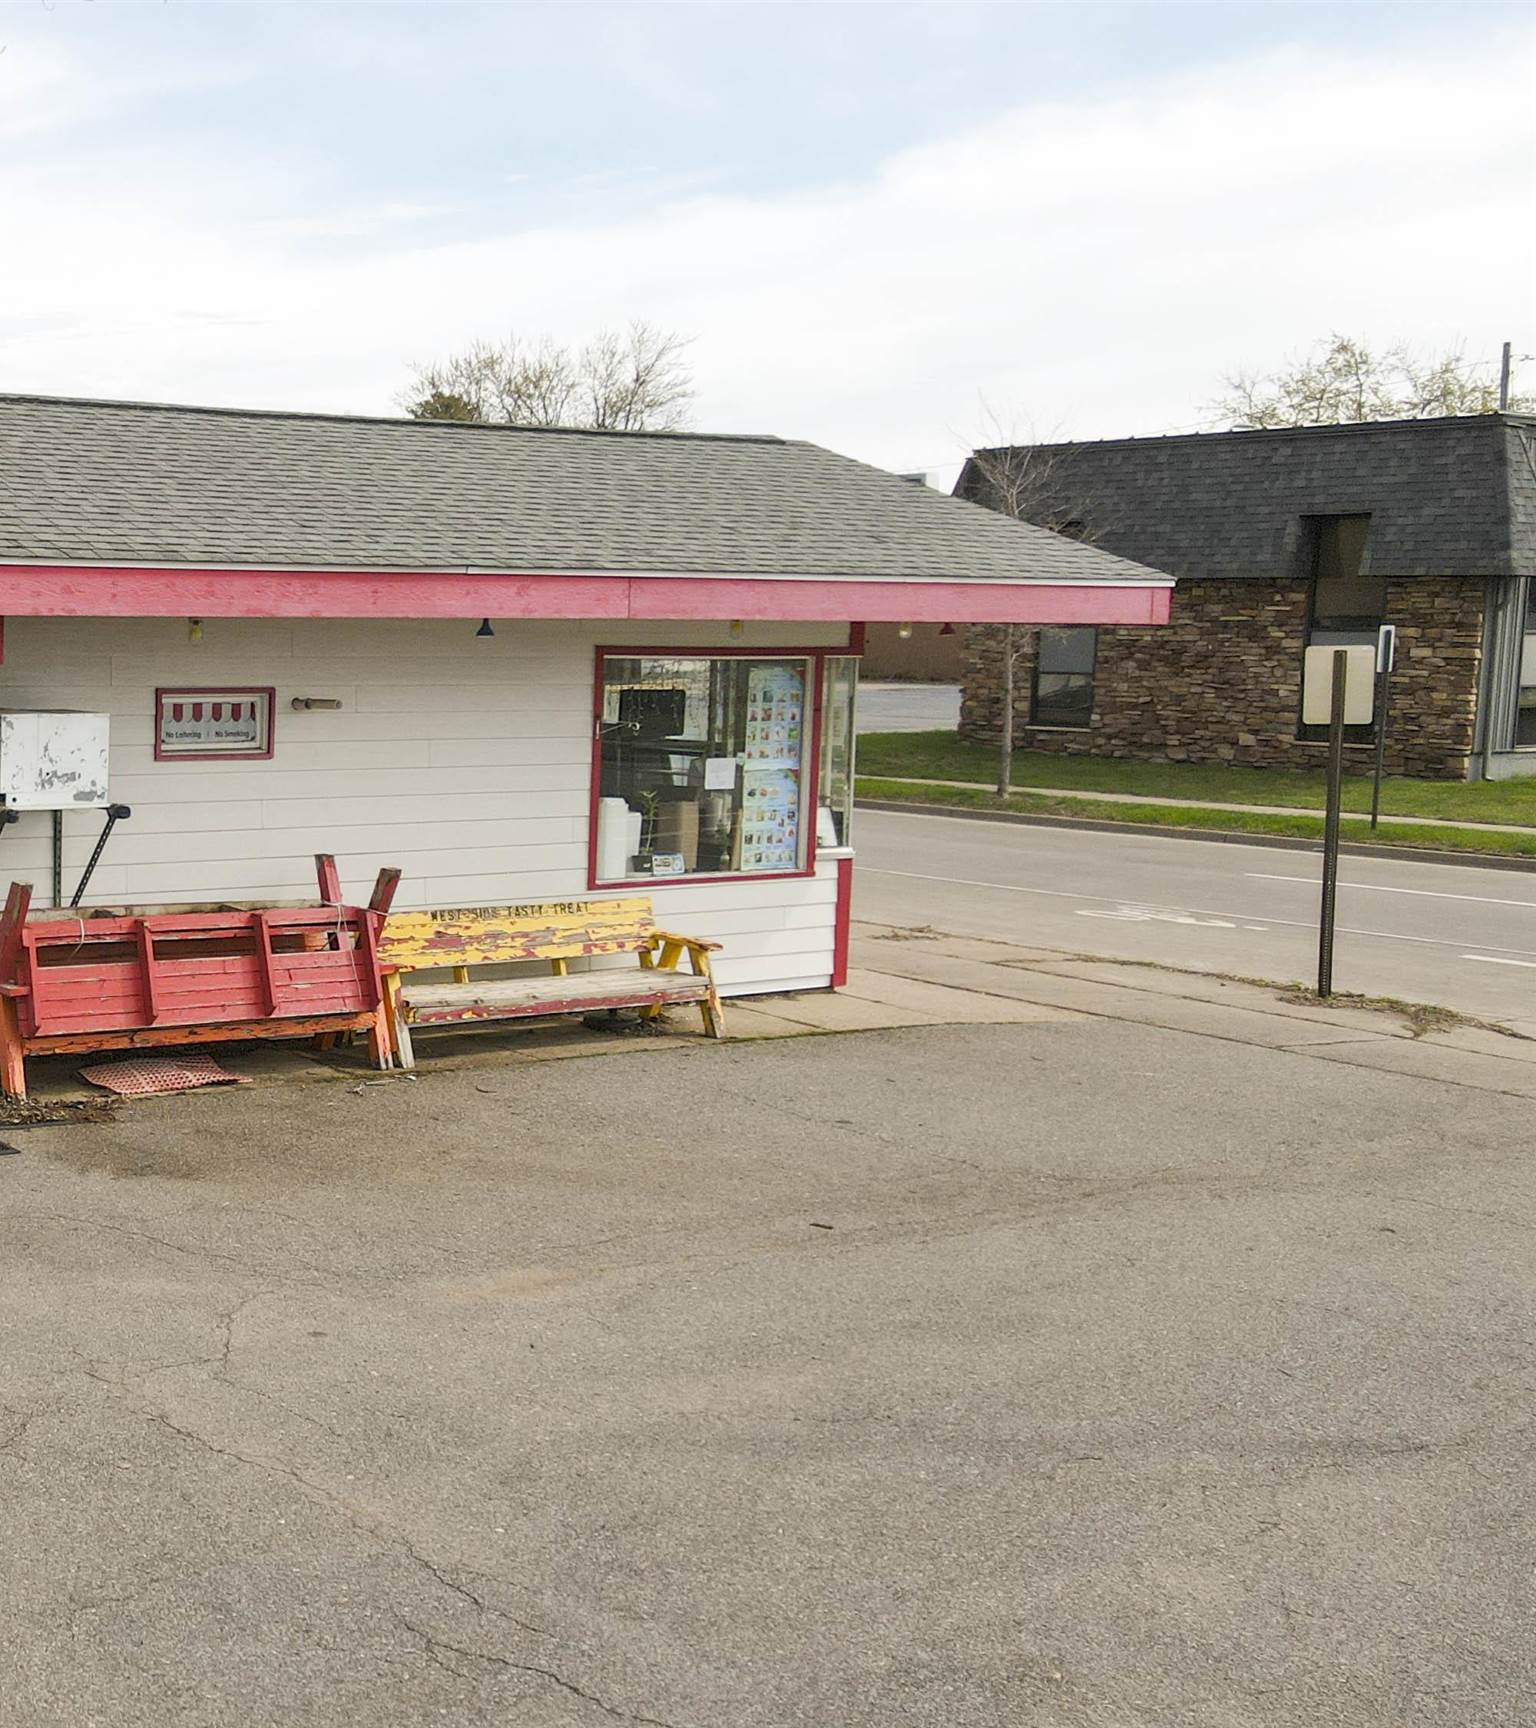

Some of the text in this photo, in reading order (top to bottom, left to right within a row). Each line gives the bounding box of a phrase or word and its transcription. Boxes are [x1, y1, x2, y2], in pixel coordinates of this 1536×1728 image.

[430, 909, 462, 923] WEST
[507, 905, 545, 919] TASTY
[553, 901, 591, 916] TREAT
